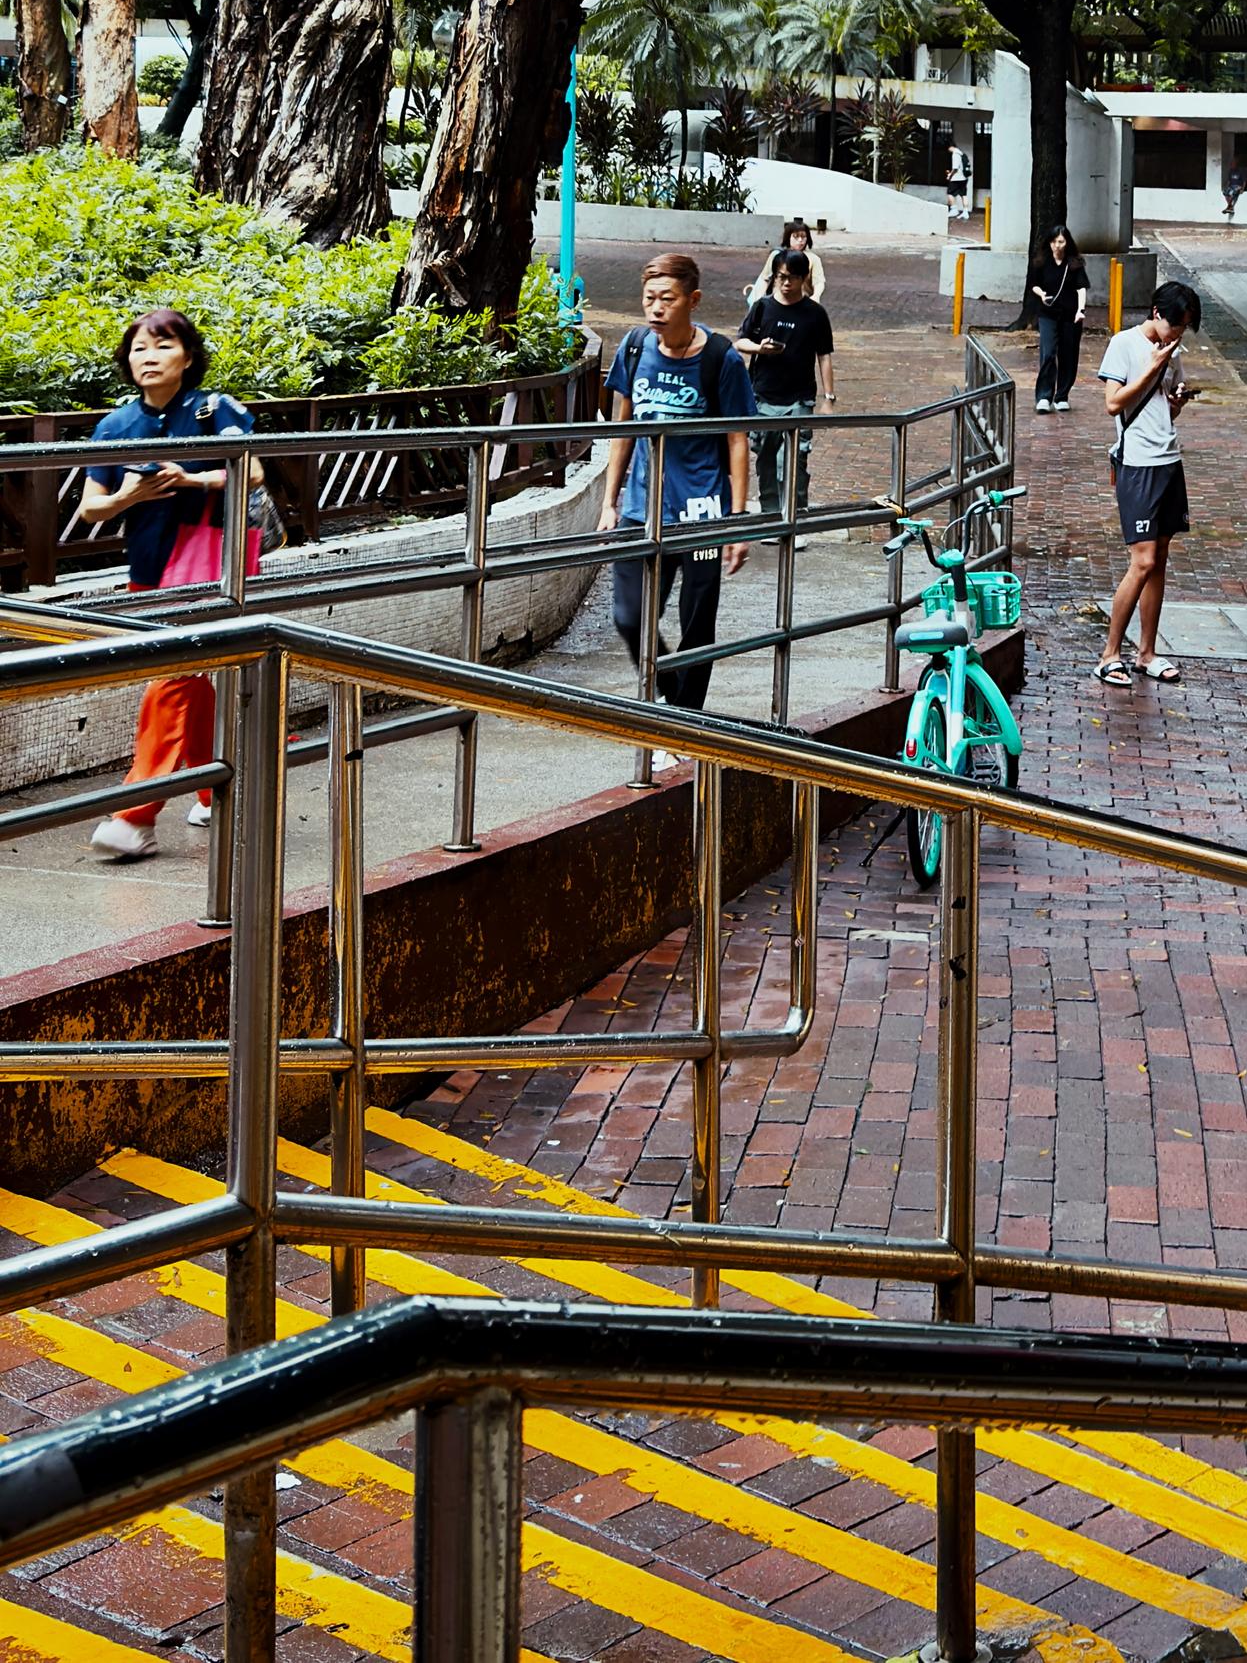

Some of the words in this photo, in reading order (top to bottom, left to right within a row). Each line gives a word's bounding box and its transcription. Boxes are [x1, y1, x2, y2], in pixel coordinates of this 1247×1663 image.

[657, 372, 686, 386] REAL
[632, 378, 707, 413] SuperD
[679, 494, 723, 522] JPN
[1135, 520, 1150, 533] 27
[693, 547, 719, 561] EVISU
